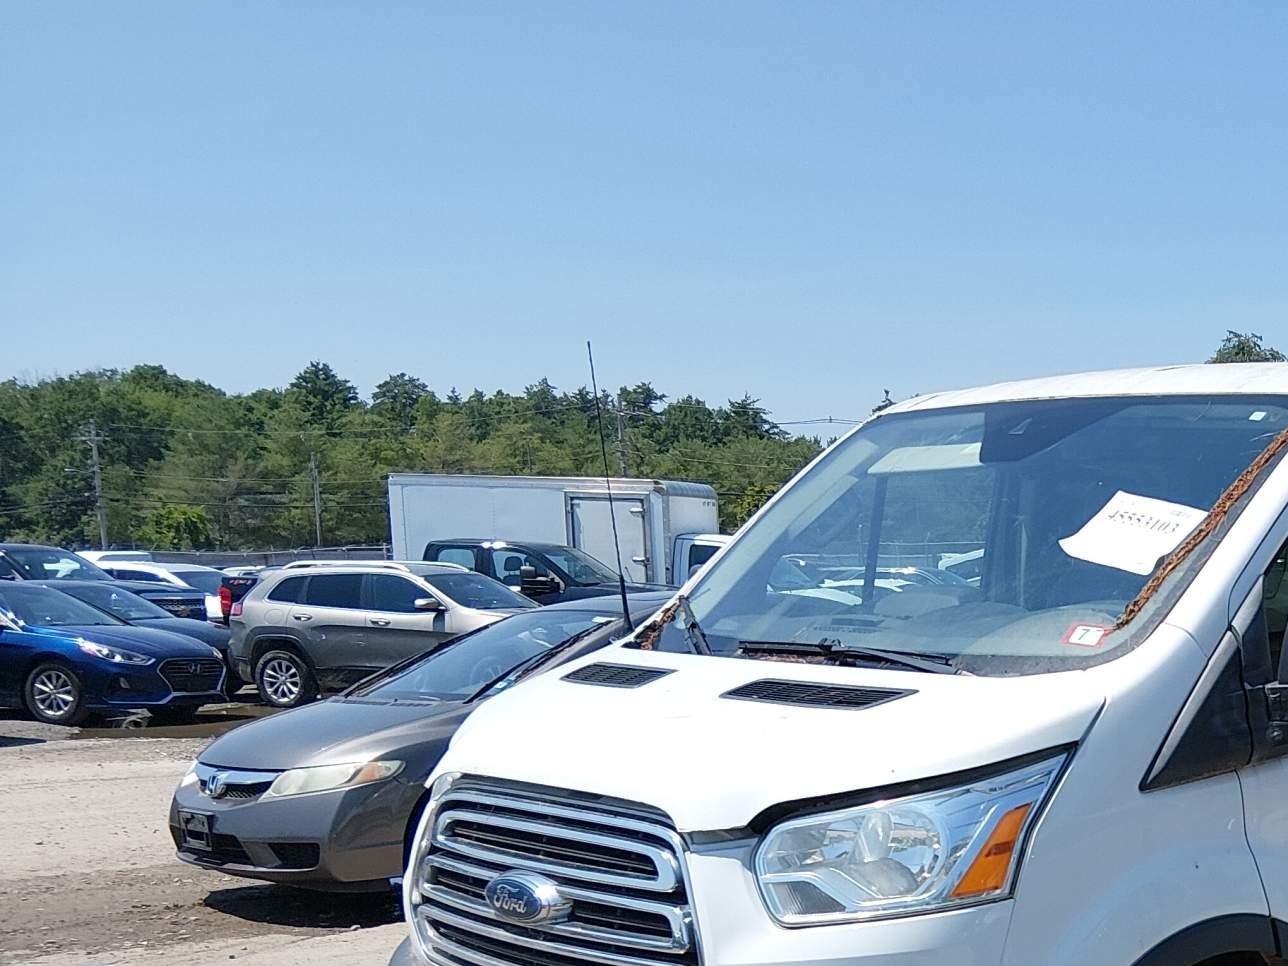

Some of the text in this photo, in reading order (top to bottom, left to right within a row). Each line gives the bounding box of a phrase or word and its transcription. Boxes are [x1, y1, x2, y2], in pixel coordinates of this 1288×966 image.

[1108, 510, 1180, 534] 45553103
[1079, 628, 1091, 641] 7
[494, 884, 528, 913] Ford
